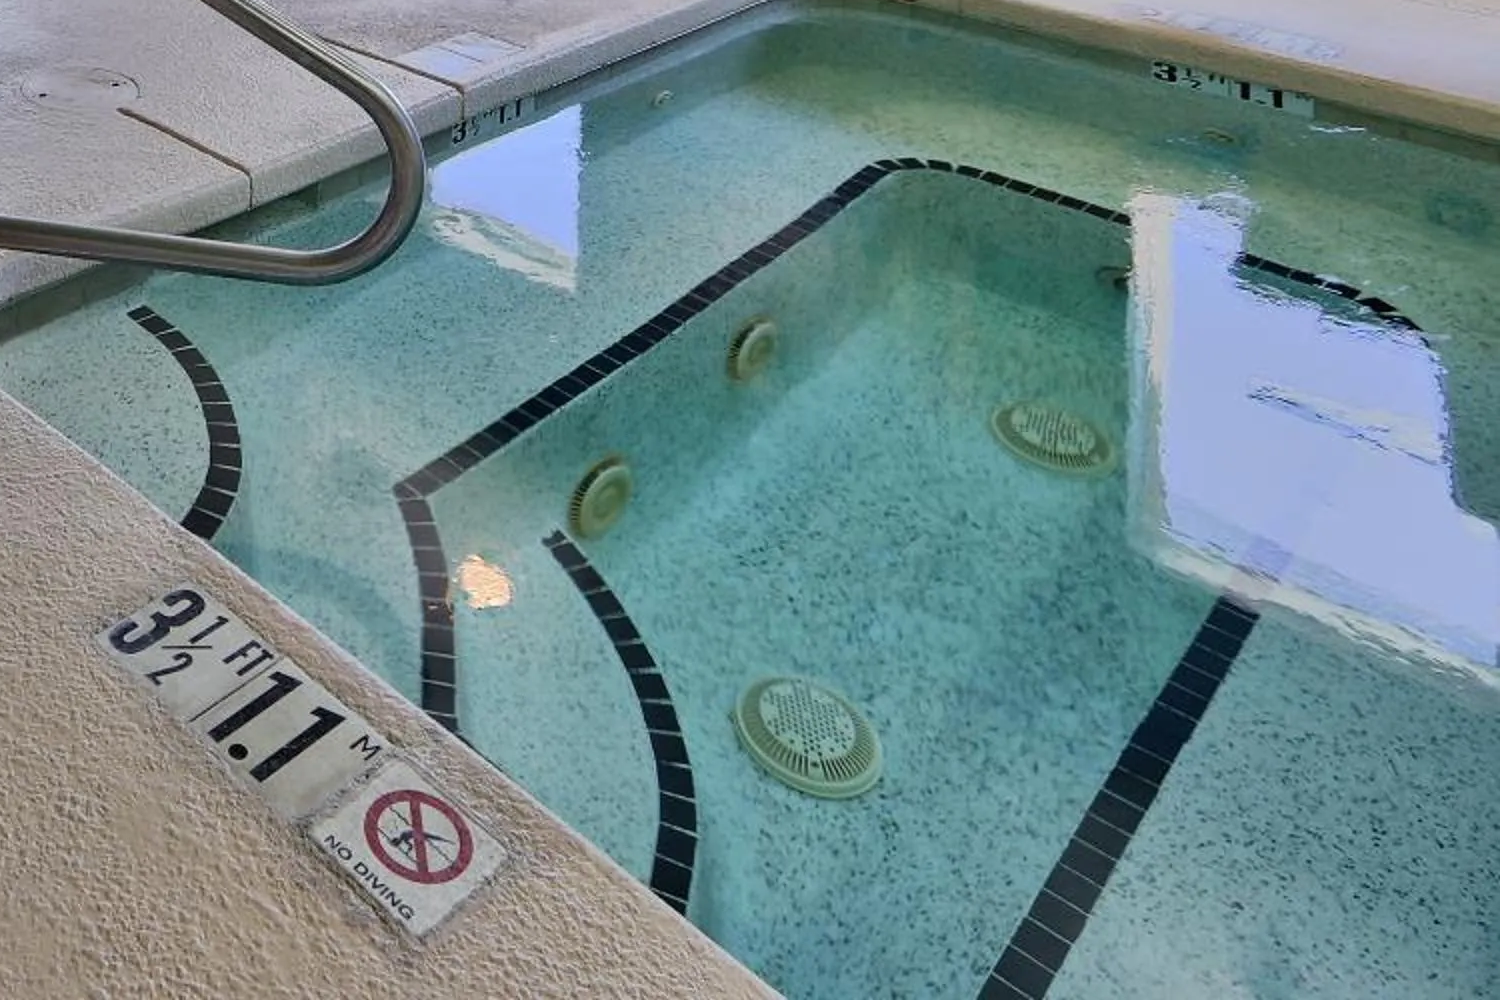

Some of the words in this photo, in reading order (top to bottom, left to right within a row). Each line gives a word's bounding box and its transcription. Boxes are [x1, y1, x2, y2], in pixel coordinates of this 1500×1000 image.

[222, 639, 275, 677] FT
[207, 670, 347, 784] 1.1
[349, 733, 382, 761] M
[323, 834, 353, 861] NO
[353, 861, 416, 921] DIVING
